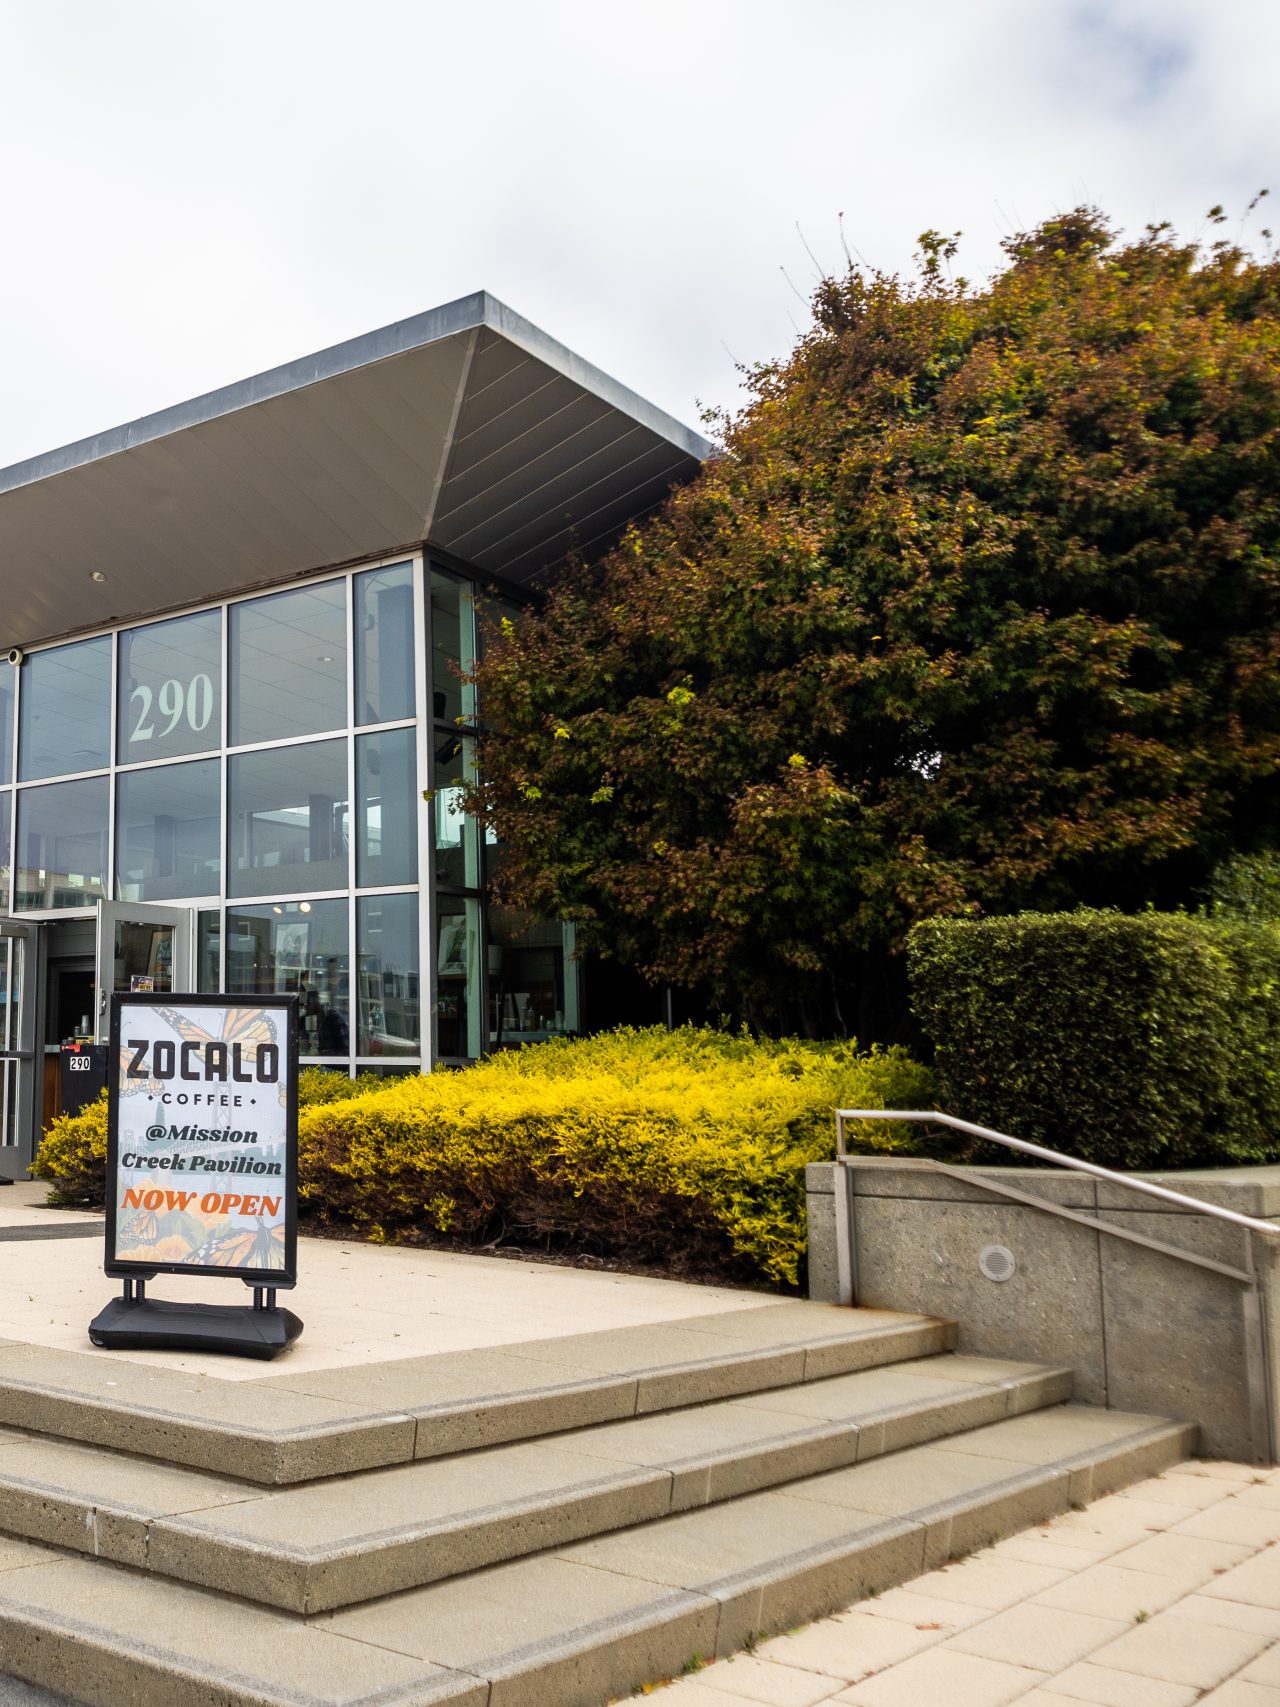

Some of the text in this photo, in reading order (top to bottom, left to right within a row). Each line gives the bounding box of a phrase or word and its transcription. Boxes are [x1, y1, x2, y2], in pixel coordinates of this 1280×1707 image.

[128, 673, 214, 743] 290
[70, 1057, 90, 1070] 290
[126, 1039, 279, 1084] ZOCALO
[161, 1092, 242, 1107] COFFEE
[145, 1124, 258, 1144] @Mission
[121, 1152, 282, 1176] Creek Pavilion
[121, 1188, 282, 1217] NOW OPEN
